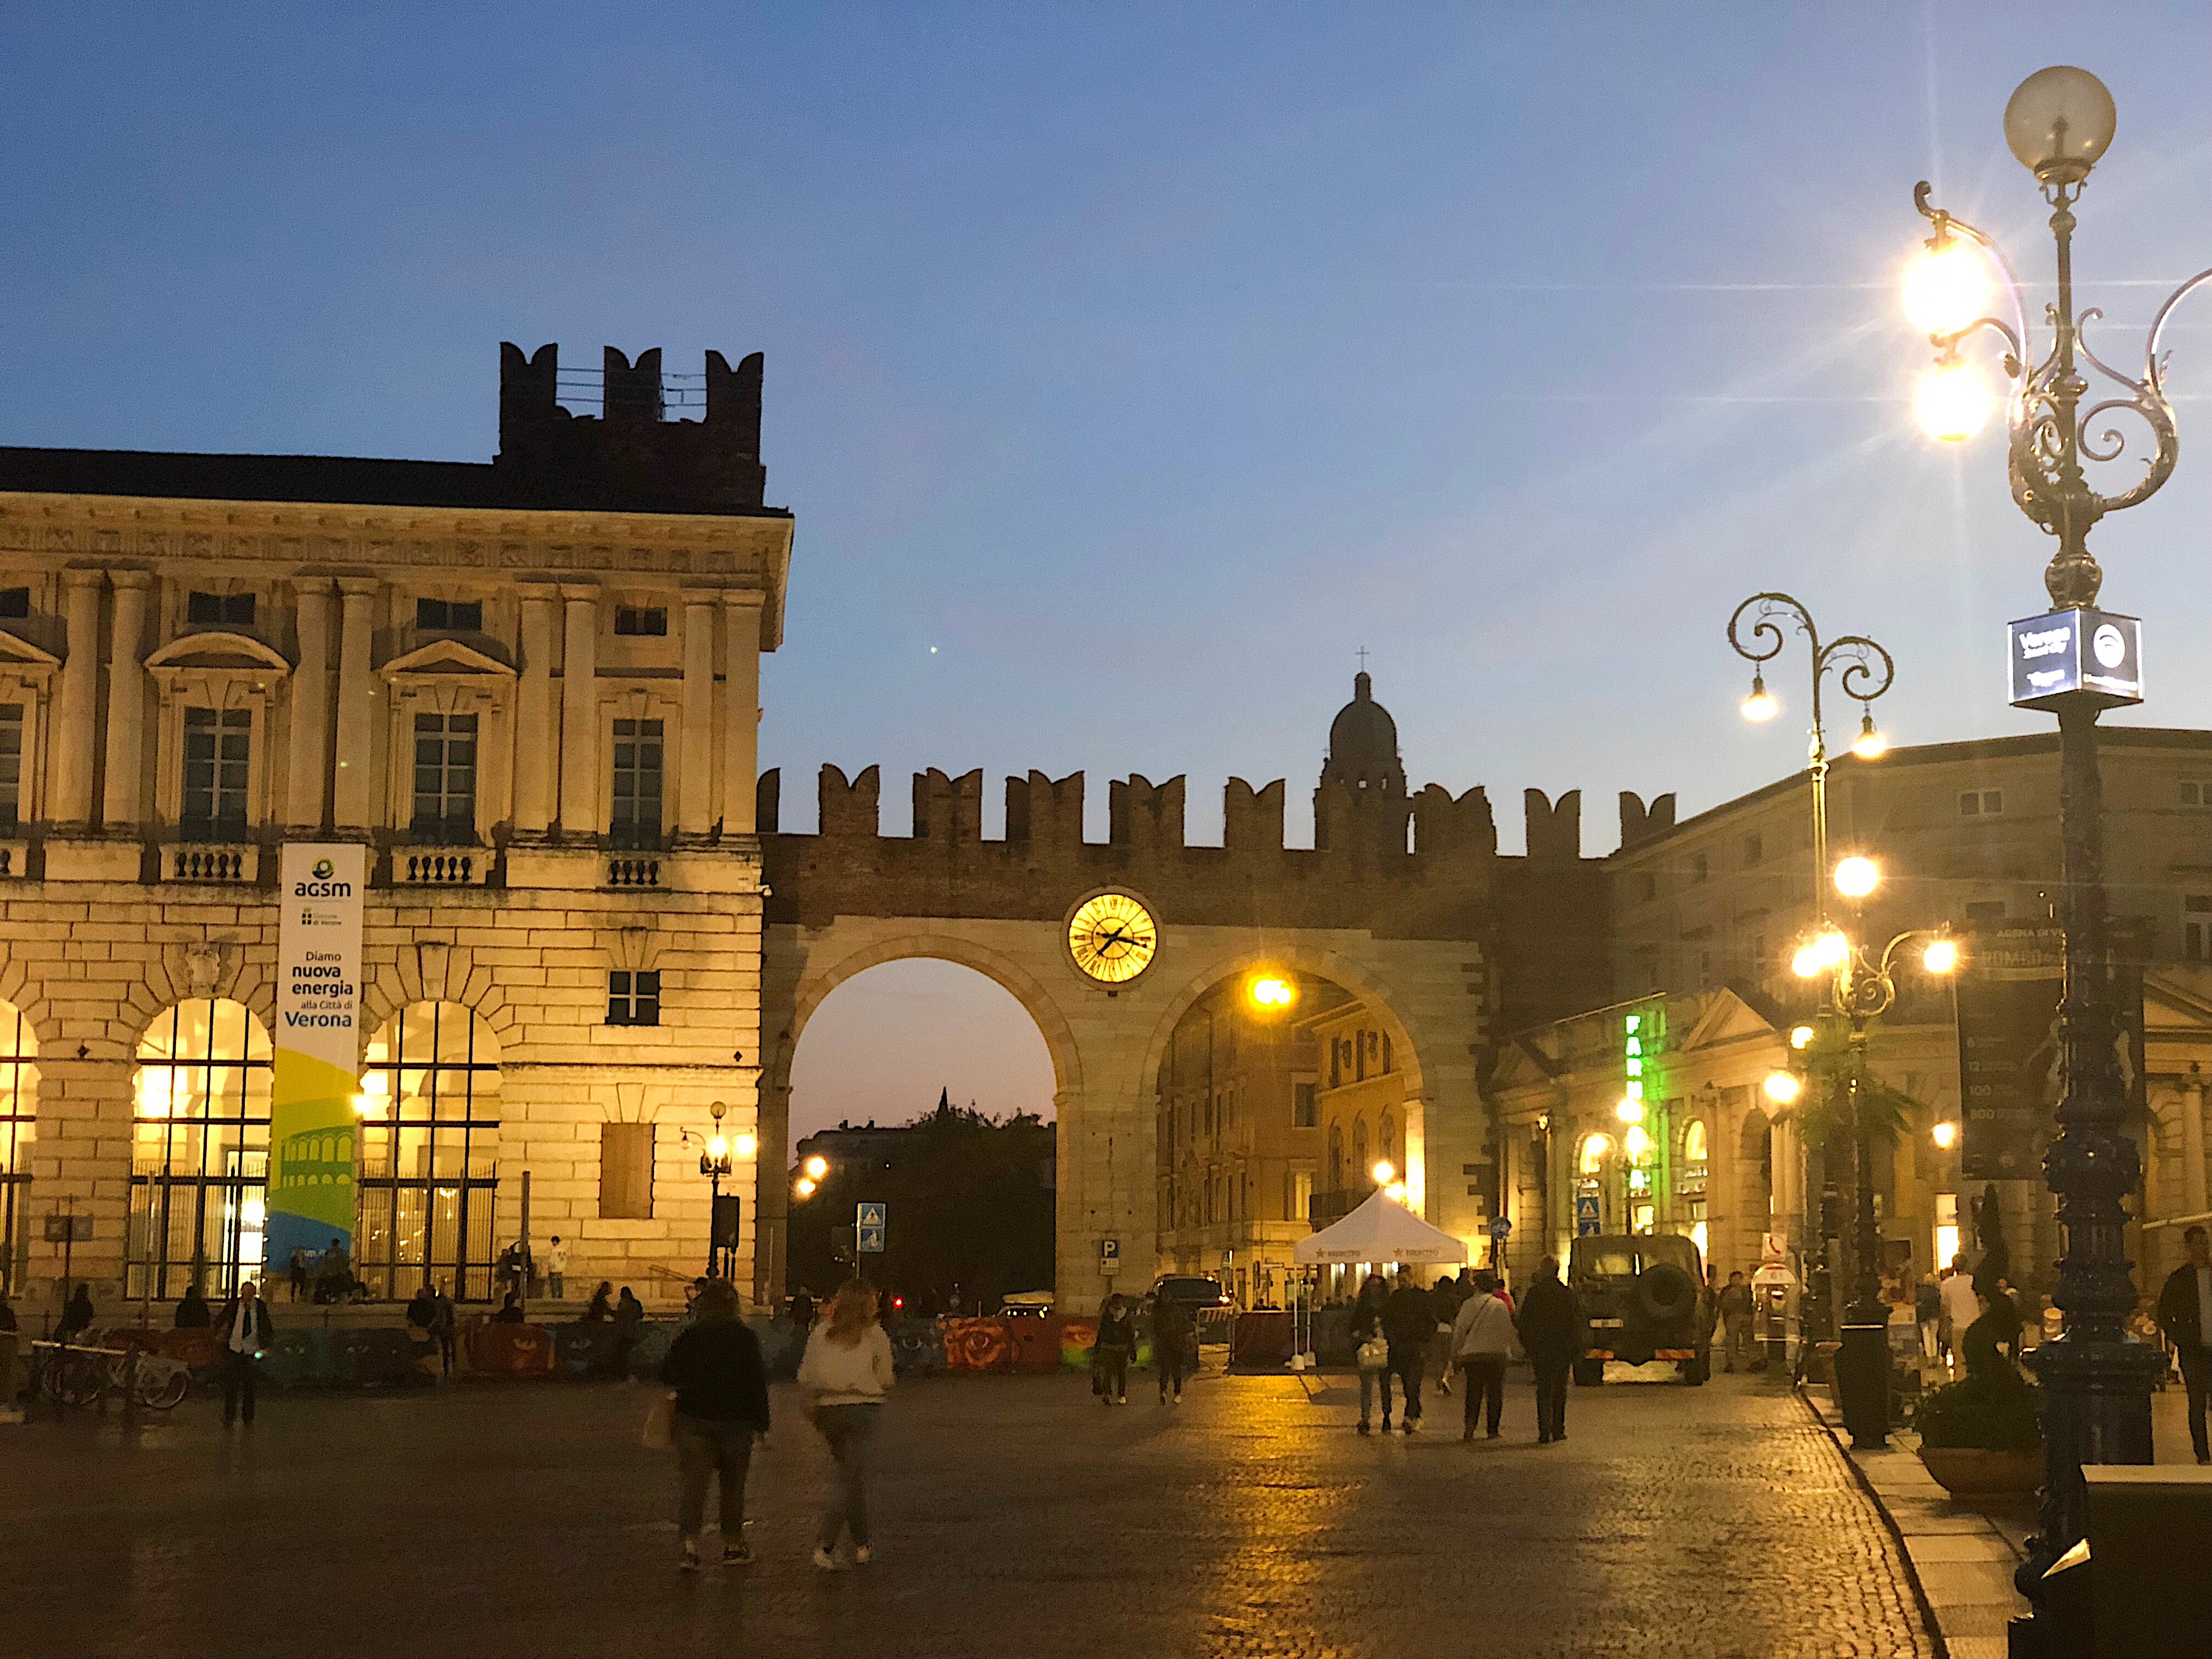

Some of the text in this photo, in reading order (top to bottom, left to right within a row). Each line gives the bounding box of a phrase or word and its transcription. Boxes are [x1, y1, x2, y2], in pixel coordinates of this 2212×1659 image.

[306, 951, 341, 961] Diamo
[292, 966, 341, 977] nuova
[292, 980, 353, 997] energia
[301, 1000, 352, 1009] alla Città di
[285, 1011, 352, 1026] Verona
[1968, 1085, 1991, 1096] 100
[1104, 1241, 1115, 1256] P
